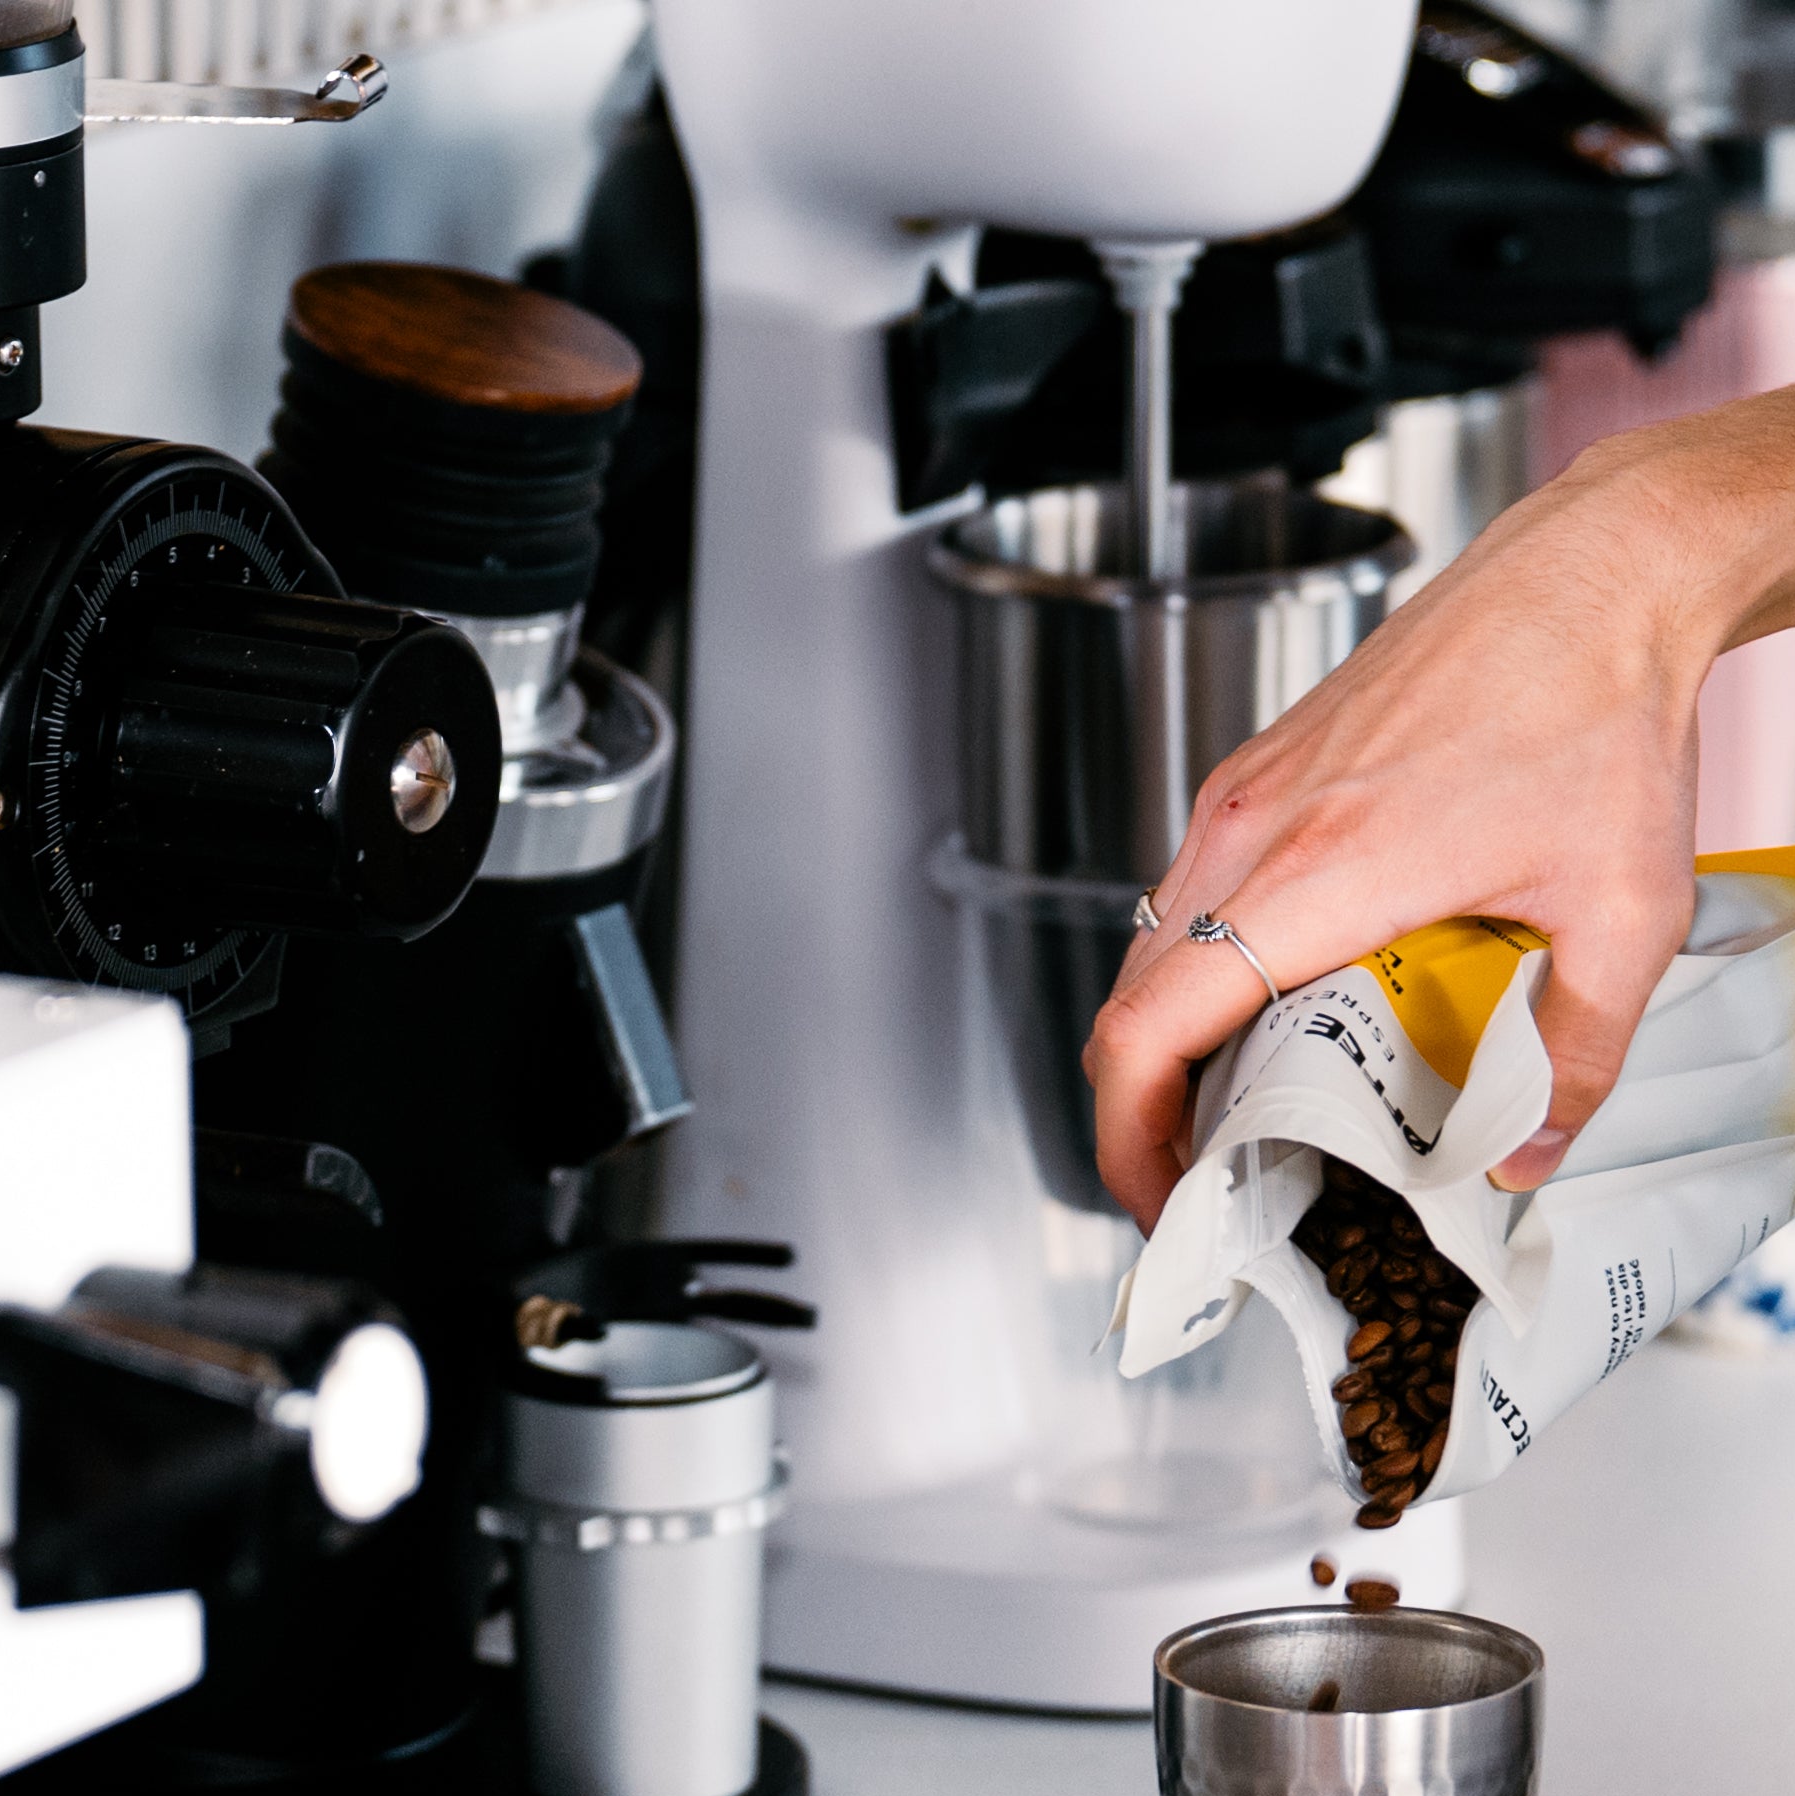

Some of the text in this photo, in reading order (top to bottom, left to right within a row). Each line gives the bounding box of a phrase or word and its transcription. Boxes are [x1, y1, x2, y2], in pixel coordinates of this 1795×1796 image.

[168, 546, 179, 564] 5
[130, 571, 140, 588] 6
[242, 567, 251, 584] 3
[80, 881, 95, 898] 11
[107, 924, 122, 942] 12
[143, 944, 157, 961] 13
[182, 940, 197, 957] 14
[1617, 1263, 1629, 1290] dla
[1605, 1267, 1618, 1308] nasz
[1629, 1258, 1646, 1319] radość
